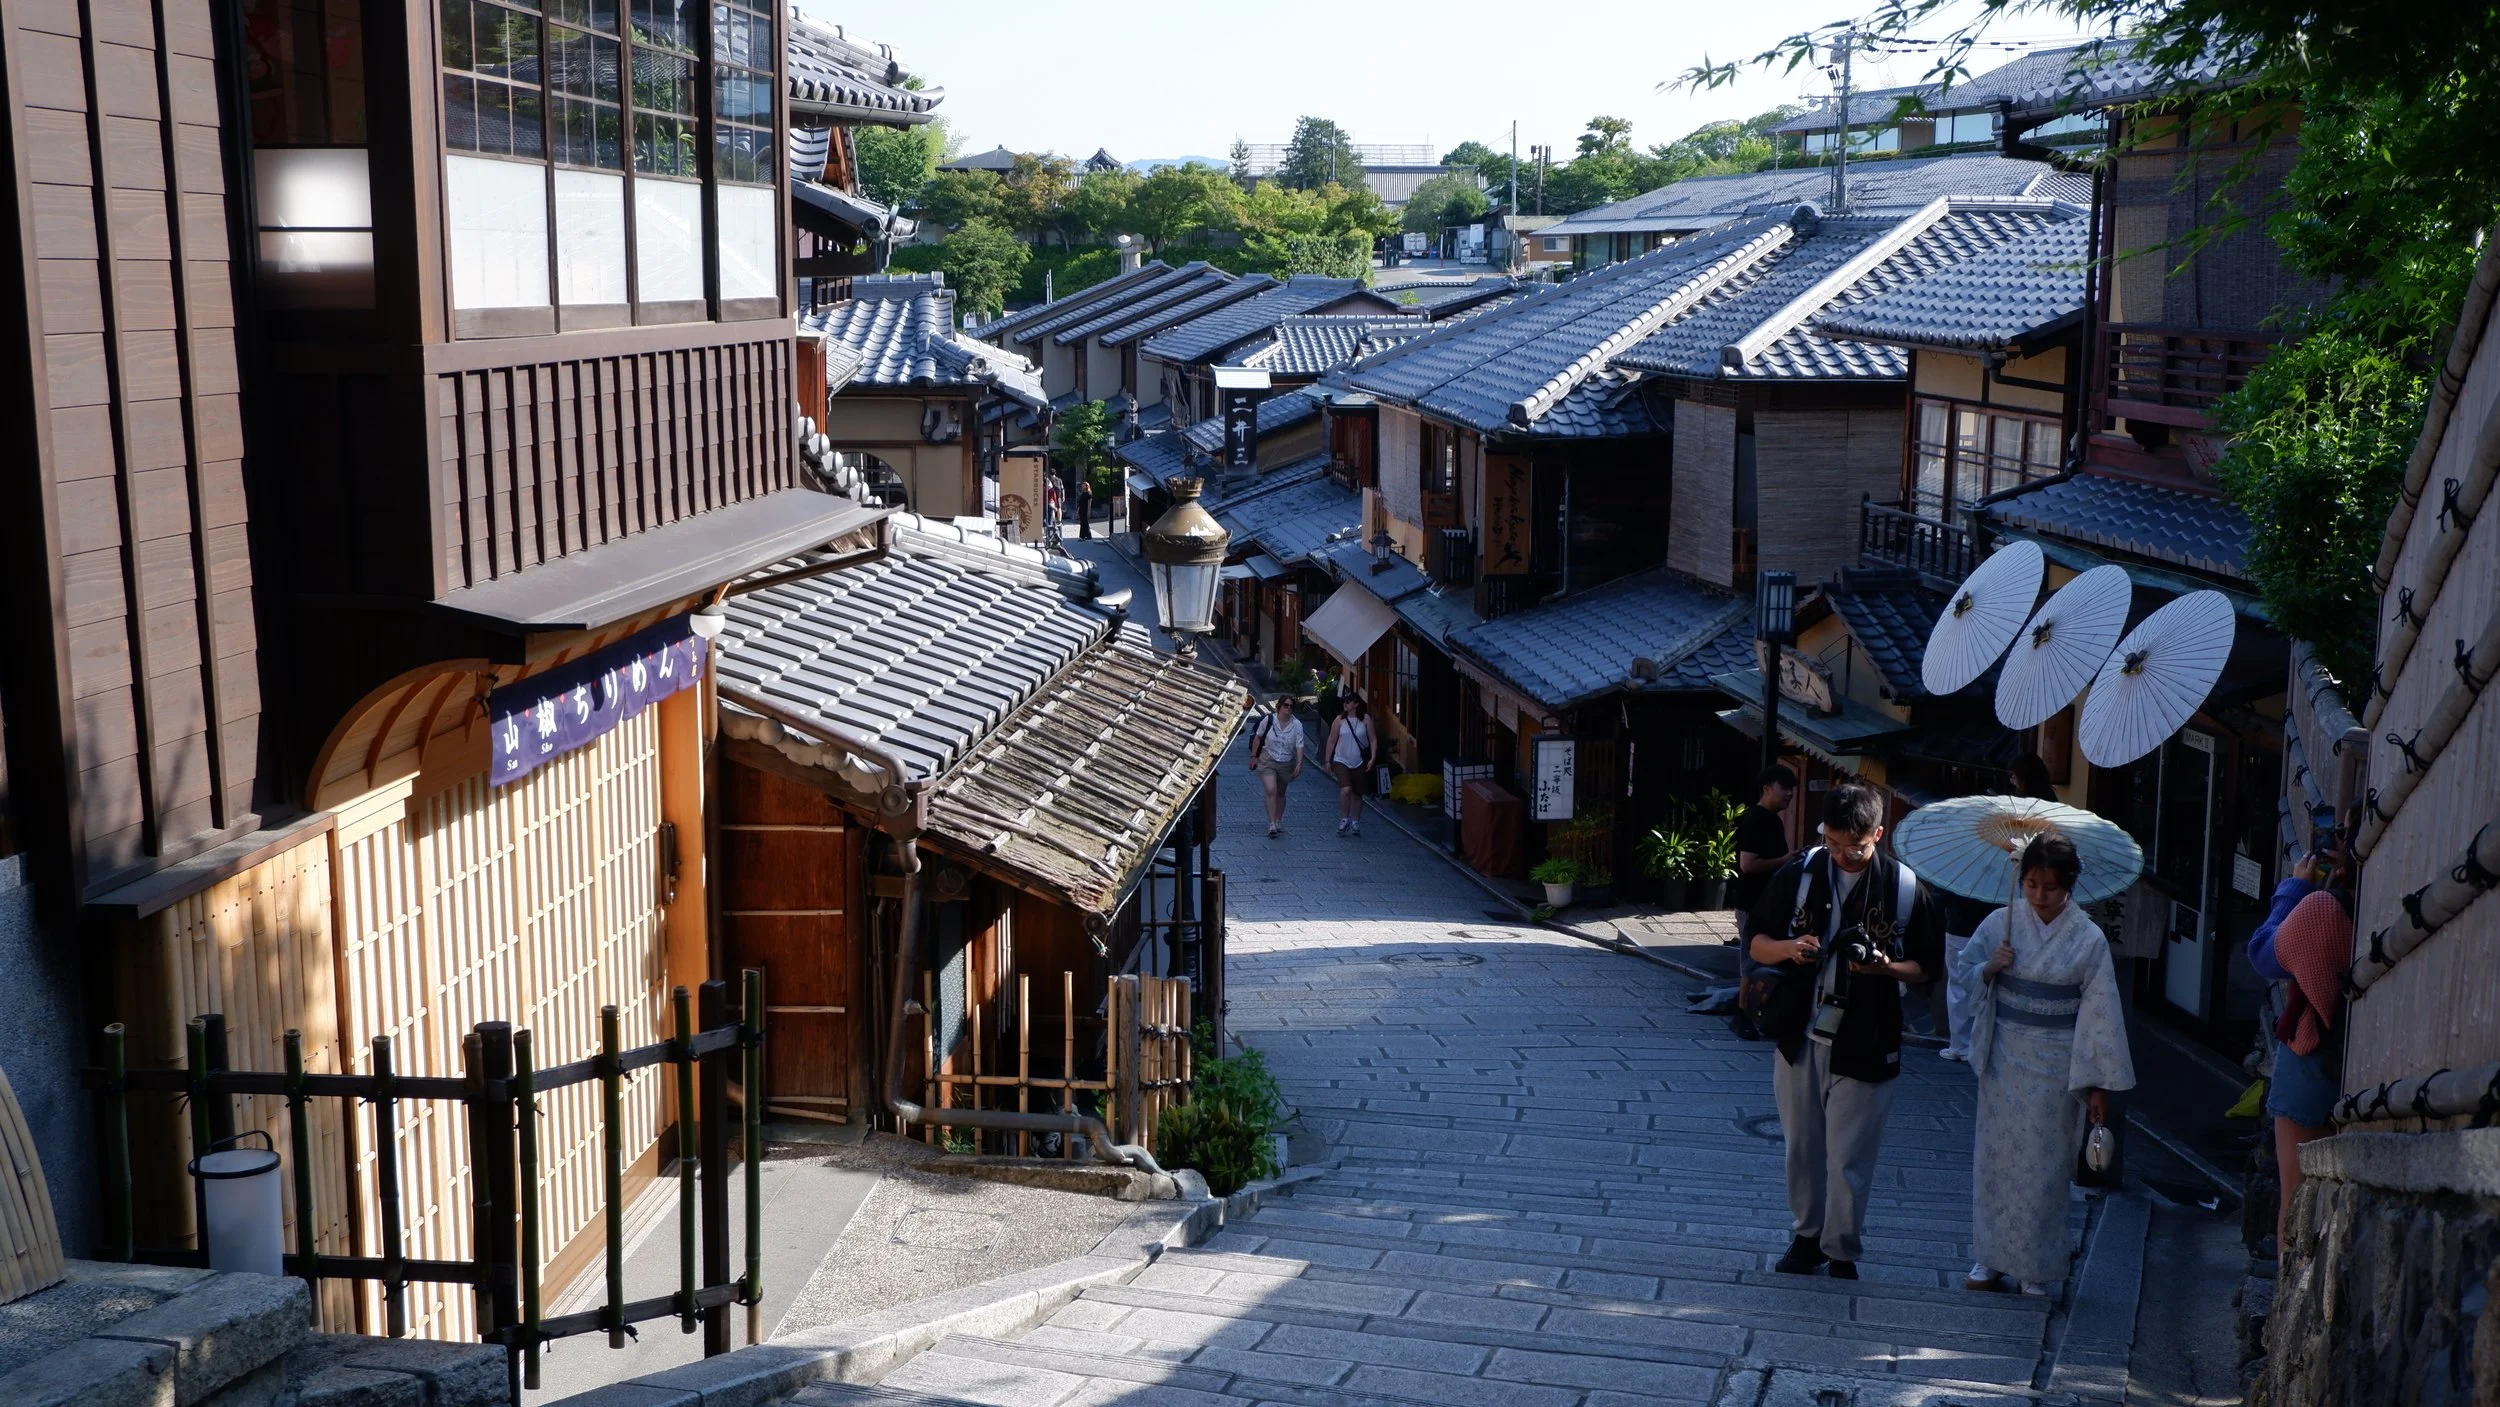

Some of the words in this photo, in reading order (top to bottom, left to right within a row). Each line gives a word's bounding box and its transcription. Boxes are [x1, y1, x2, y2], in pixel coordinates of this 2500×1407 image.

[1231, 396, 1253, 466] 二井三
[1563, 746, 1573, 777] そば処
[1539, 780, 1551, 812] ふたば
